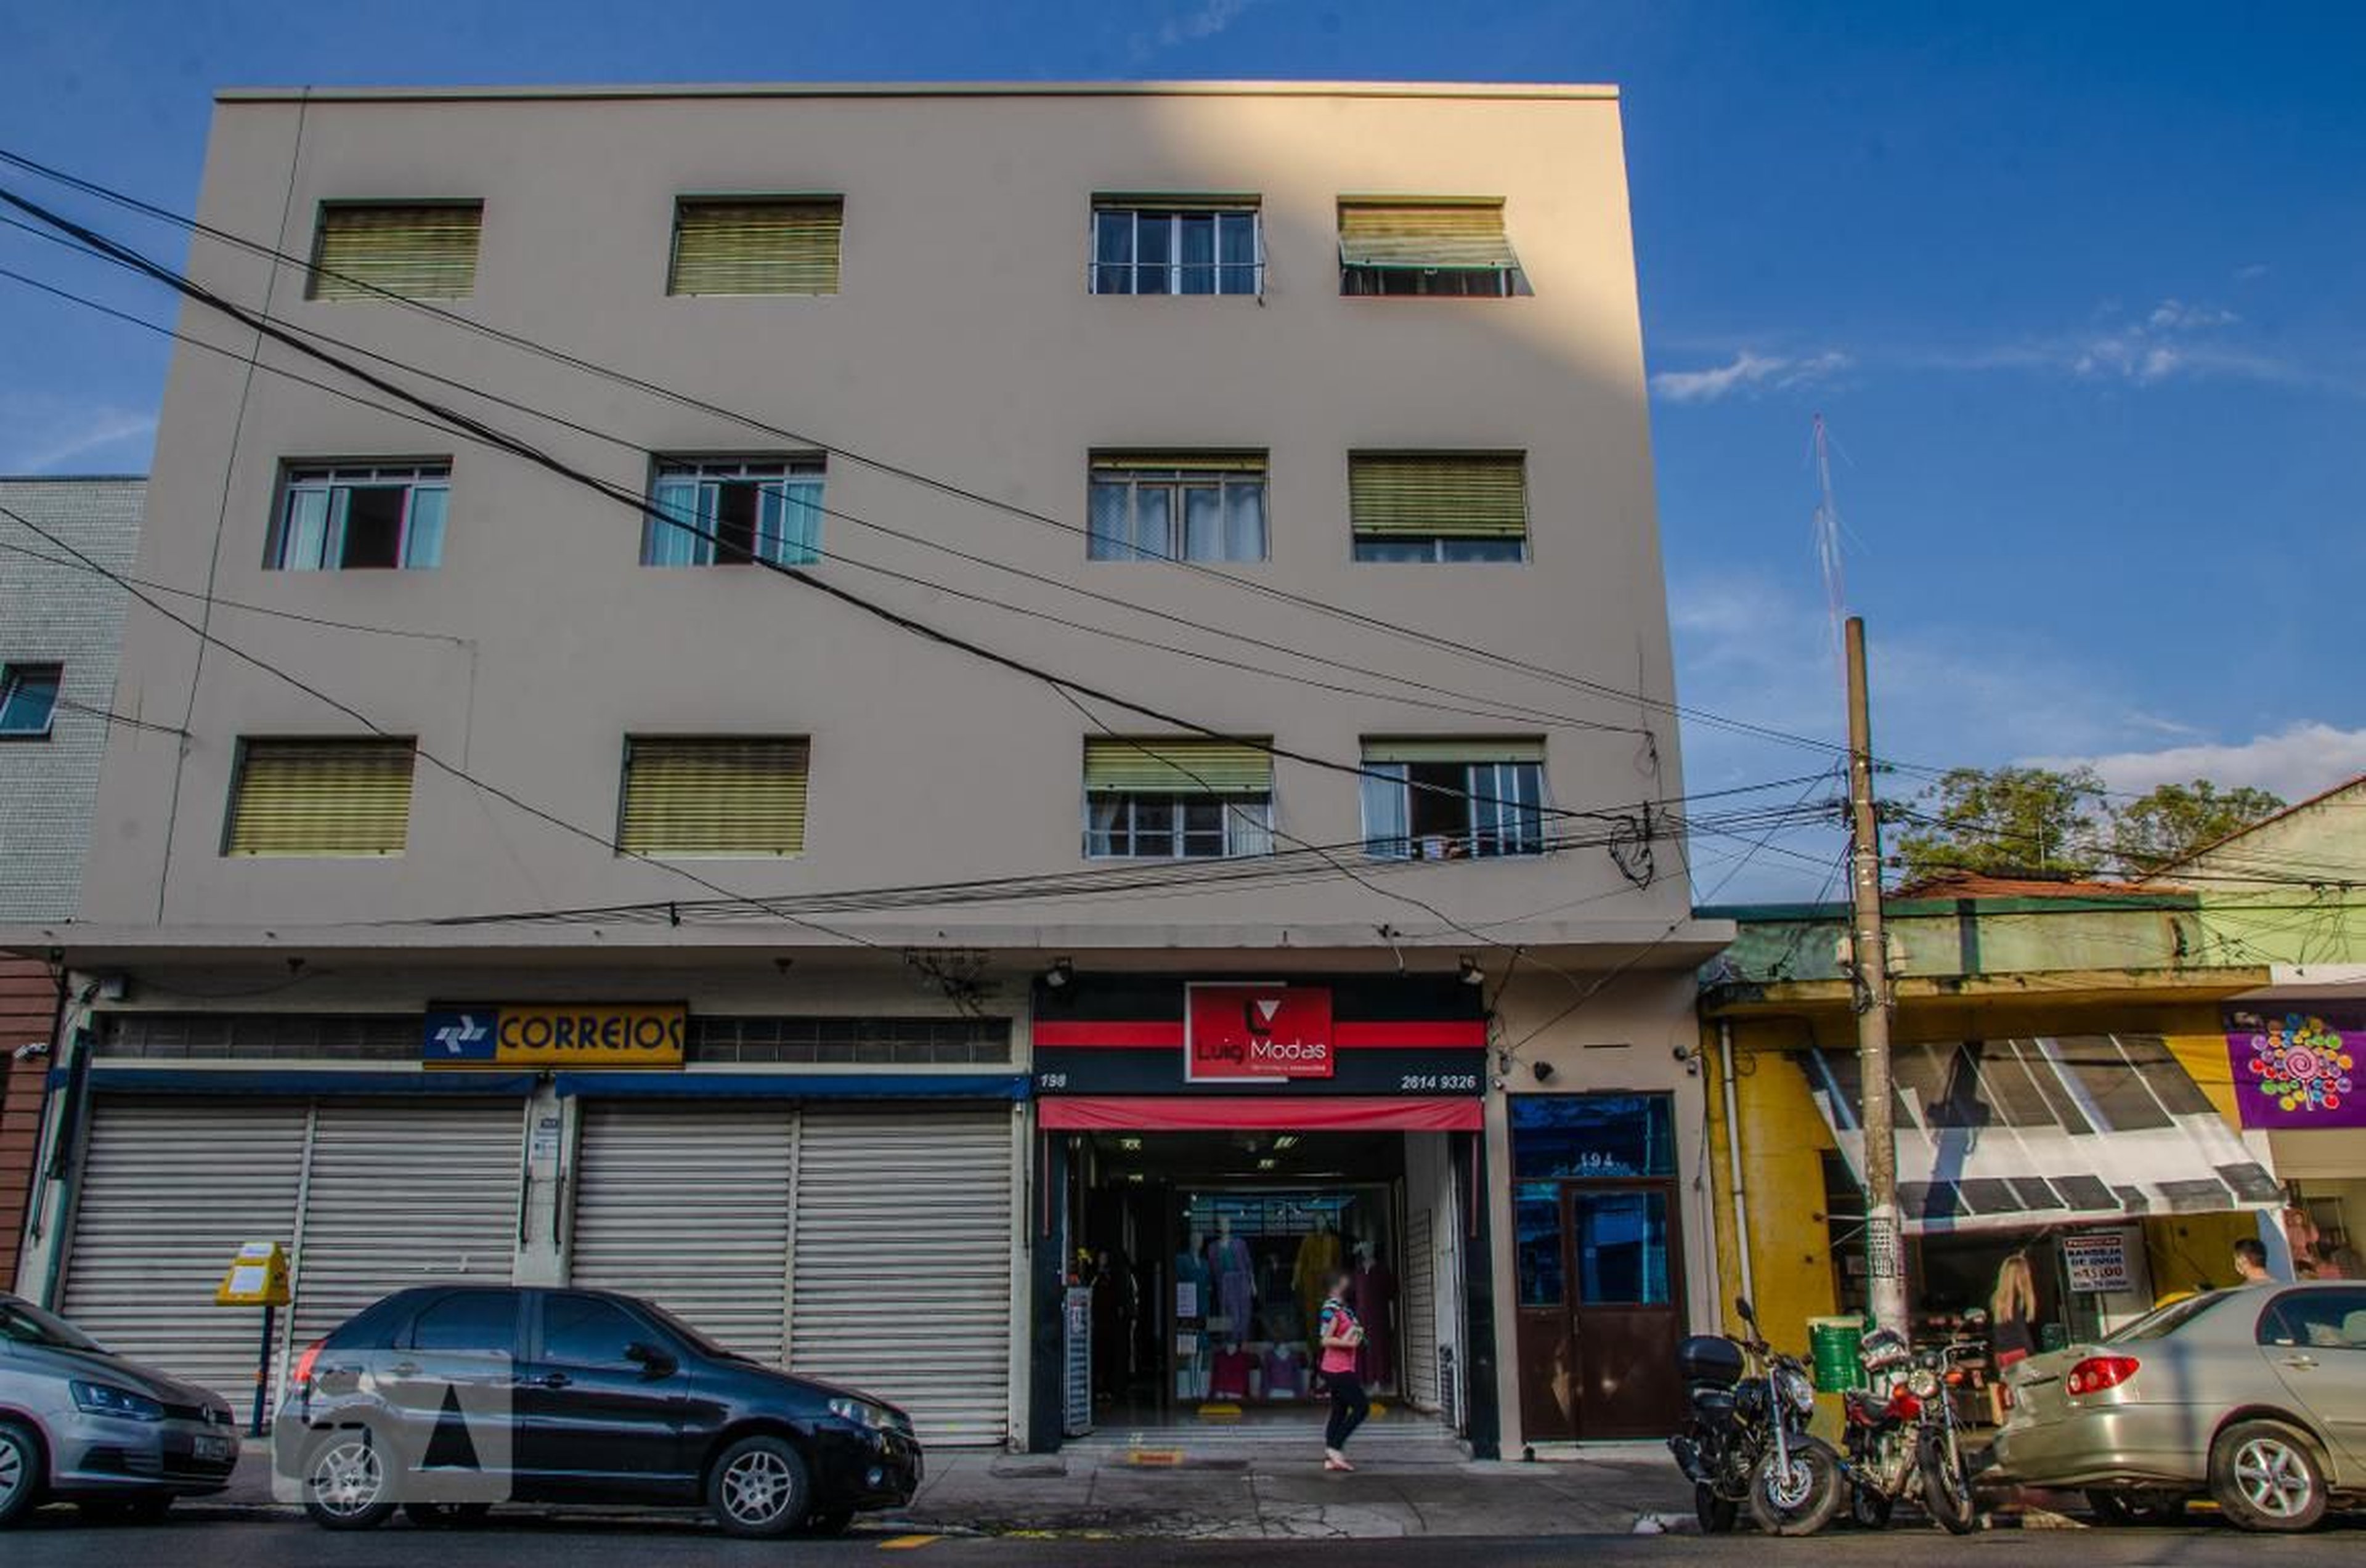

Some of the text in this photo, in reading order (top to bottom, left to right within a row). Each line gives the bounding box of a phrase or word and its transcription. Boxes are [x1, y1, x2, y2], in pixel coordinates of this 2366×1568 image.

[500, 1017, 682, 1049] CORREIOS
[1251, 1038, 1326, 1059] Modas
[1441, 1075, 1477, 1089] 9326
